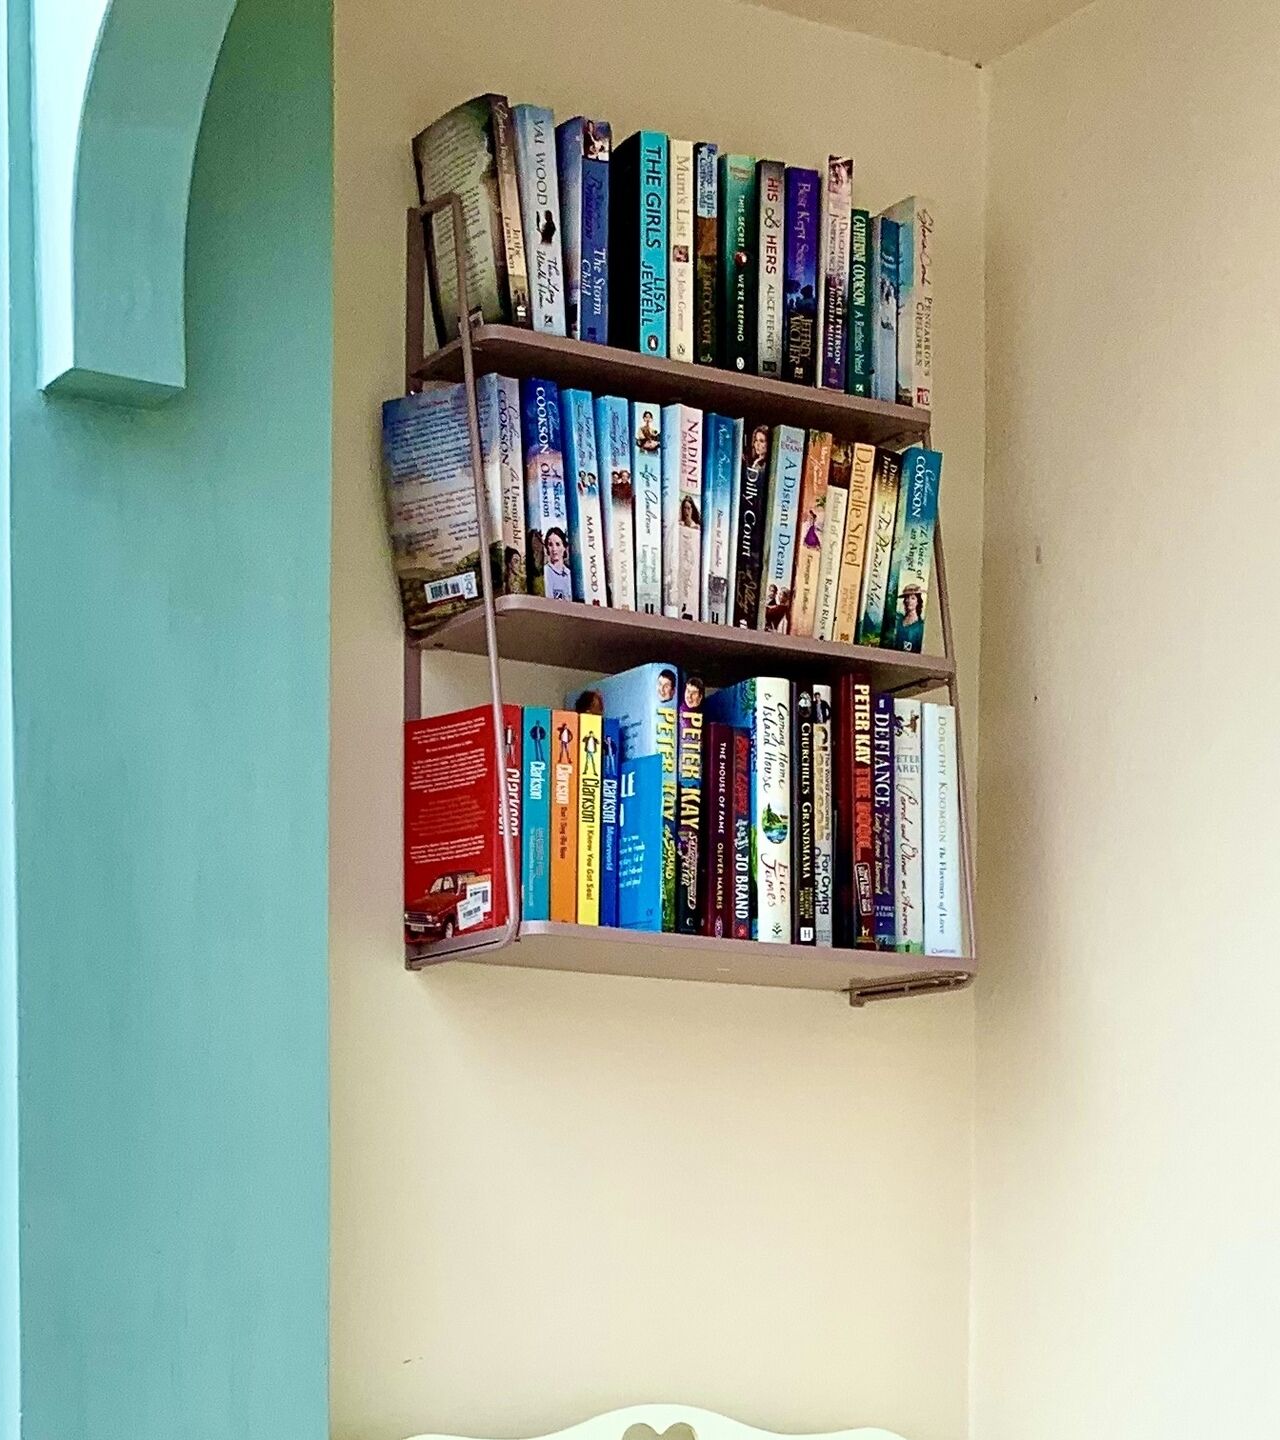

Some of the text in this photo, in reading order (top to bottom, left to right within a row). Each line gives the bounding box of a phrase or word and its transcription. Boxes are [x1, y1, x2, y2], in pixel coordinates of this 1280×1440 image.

[534, 151, 548, 205] WOOD
[645, 146, 661, 249] THE GIRLS
[676, 155, 691, 237] Mum's List
[767, 178, 778, 202] HIS
[737, 194, 746, 248] THIS SECRET
[795, 210, 810, 239] Kept
[851, 215, 867, 263] CATHERINE
[581, 259, 592, 296] Child
[592, 247, 607, 315] The Storm
[766, 235, 778, 274] HERS
[641, 261, 654, 327] JEWELL
[653, 276, 666, 314] LISA
[736, 274, 745, 343] WE'RE KEEPING
[767, 284, 775, 314] ALICE
[852, 264, 866, 307] COOKSON
[766, 315, 775, 351] FEENEY
[788, 311, 802, 365] ARCHER
[826, 286, 837, 359] JUDITH MILLER
[833, 317, 843, 366] PETERSON
[498, 389, 510, 466] COOKSON
[535, 386, 550, 453] COOKSON
[686, 419, 699, 489] NADINE
[540, 462, 551, 518] Obsession
[552, 481, 564, 519] Sister's
[741, 466, 759, 558] Dilly Court
[844, 447, 873, 568] Danielle Steel
[911, 455, 925, 518] COOKSON
[775, 457, 797, 580] A Distant Dream
[585, 515, 599, 593] MARY WOOD
[618, 521, 628, 597] MARY WOOD
[904, 527, 918, 572] an Angel
[916, 539, 929, 583] Voice of
[822, 577, 833, 608] Rachel
[656, 709, 676, 777] PETER
[762, 706, 776, 793] Island House
[770, 701, 790, 791] Coming Home
[854, 683, 871, 765] PETER KAY
[936, 715, 948, 776] DOROTHY
[529, 760, 546, 800] Clarkson
[556, 762, 574, 805] Clarkson
[680, 712, 703, 830] PETER KAY
[800, 722, 812, 795] CHURCHILL'S
[874, 713, 891, 808] DEFIANCE
[602, 778, 618, 871] Clarkson Motorworld
[717, 809, 725, 834] FAME
[718, 796, 725, 808] OF
[938, 781, 948, 843] KOOMSON
[581, 777, 600, 901] Clarkson Know You Got Soul
[736, 852, 749, 872] JO
[801, 802, 813, 880] GRANDMAMA
[715, 876, 723, 910] HARRIS
[735, 874, 749, 919] BRAND
[760, 852, 777, 907] James
[773, 860, 789, 904] Erica
[819, 853, 832, 915] For Crying
[937, 901, 948, 911] of
[938, 861, 947, 900] Flavours
[938, 912, 947, 935] Love
